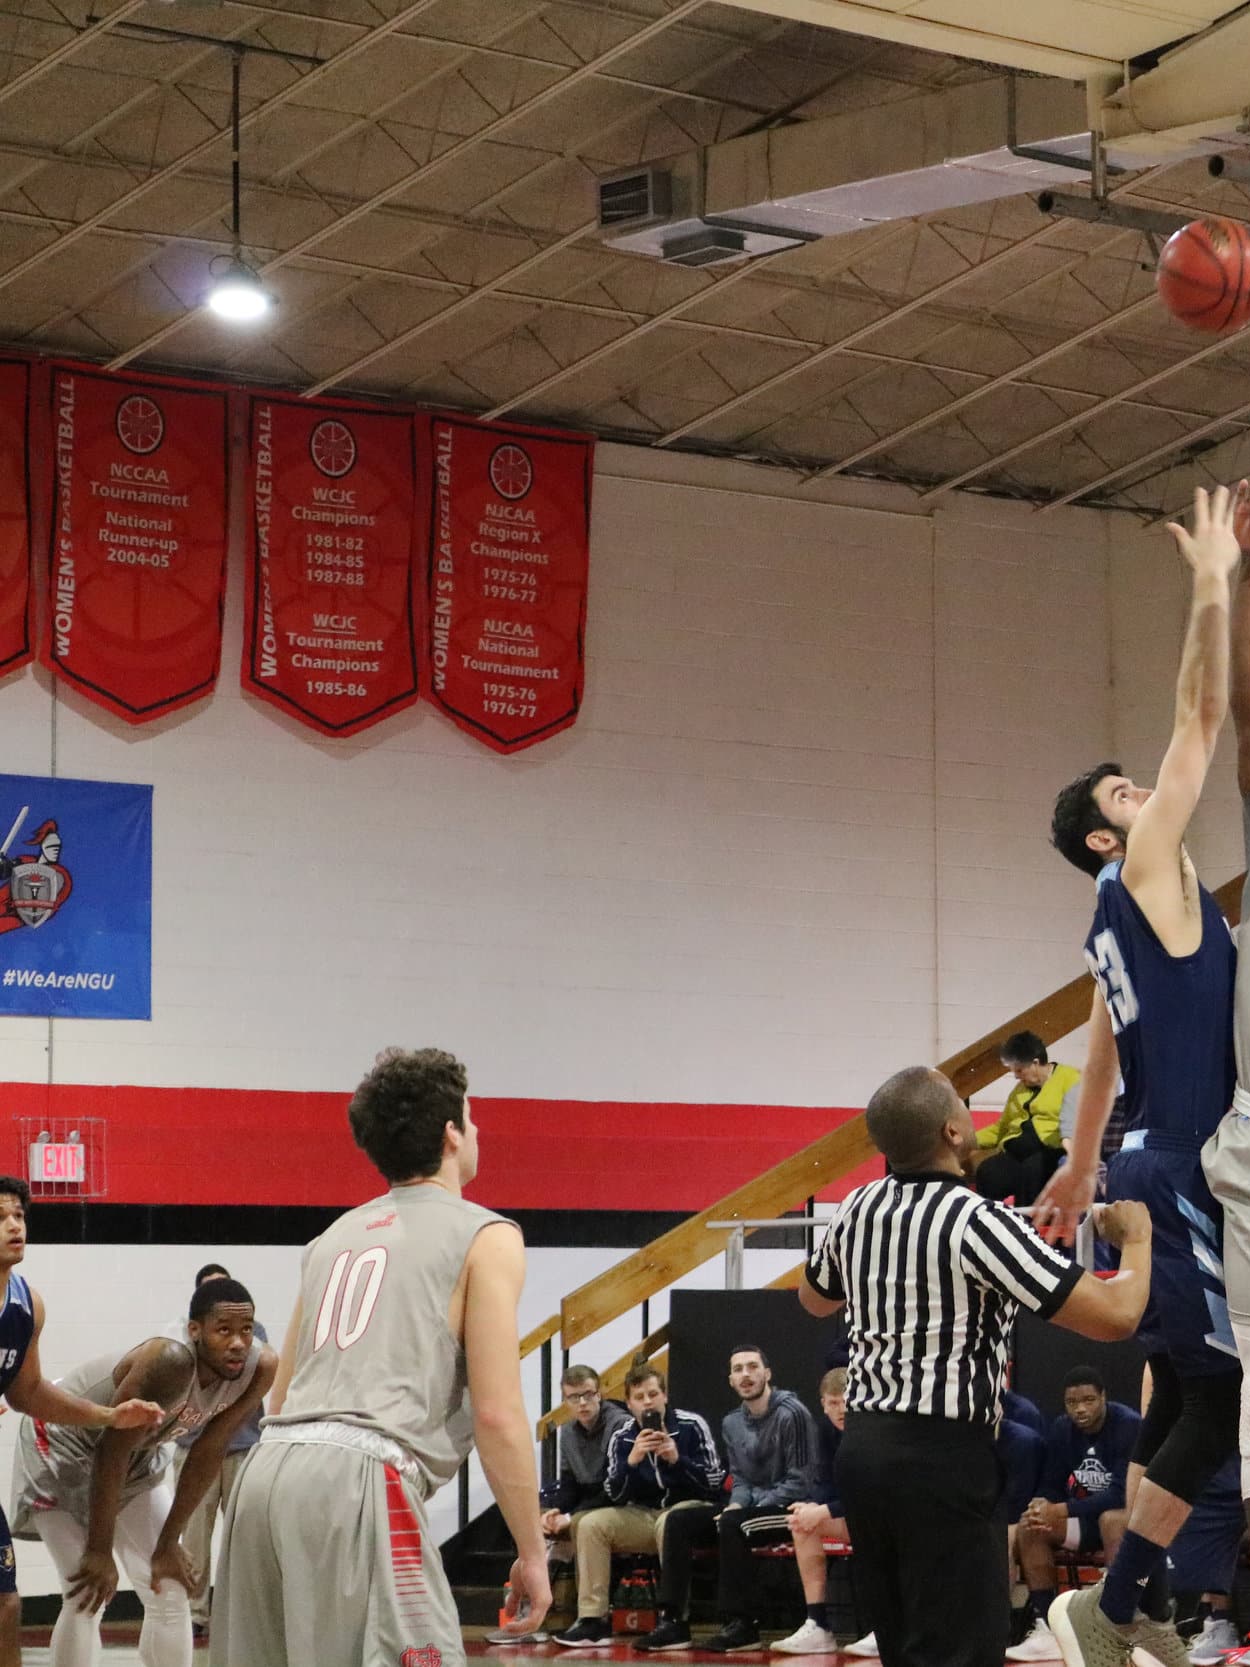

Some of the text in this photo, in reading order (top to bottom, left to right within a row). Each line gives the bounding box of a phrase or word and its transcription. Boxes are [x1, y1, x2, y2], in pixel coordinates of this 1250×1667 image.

[110, 463, 169, 483] NCCAA
[90, 481, 189, 507] Tournament
[313, 487, 357, 504] WCJC
[106, 511, 172, 532] National
[291, 506, 375, 528] Champions
[485, 503, 536, 522] NJCAA
[99, 529, 179, 551] Runner-up
[306, 534, 364, 550] 1981-82
[479, 522, 541, 544] Region X
[107, 548, 169, 568] 2004-05
[306, 551, 364, 568] 1984-85
[470, 541, 550, 565] Champions
[306, 569, 364, 586] 1987-88
[483, 567, 537, 586] 1975-76
[54, 538, 76, 657] WOMEN'S
[483, 584, 537, 603] 1976-77
[313, 613, 357, 630] WCJC
[483, 619, 534, 637] NJCAA
[285, 631, 384, 652] Tournament
[433, 578, 454, 690] WOMEN'S
[478, 638, 539, 658] National
[291, 653, 380, 674] Champions
[306, 681, 367, 697] 1985-86
[483, 682, 537, 701] 1975-76
[483, 700, 537, 718] 1976-77
[3, 969, 116, 990] #WeAreNGU
[43, 1146, 79, 1177] EXIT
[313, 1245, 389, 1353] 10
